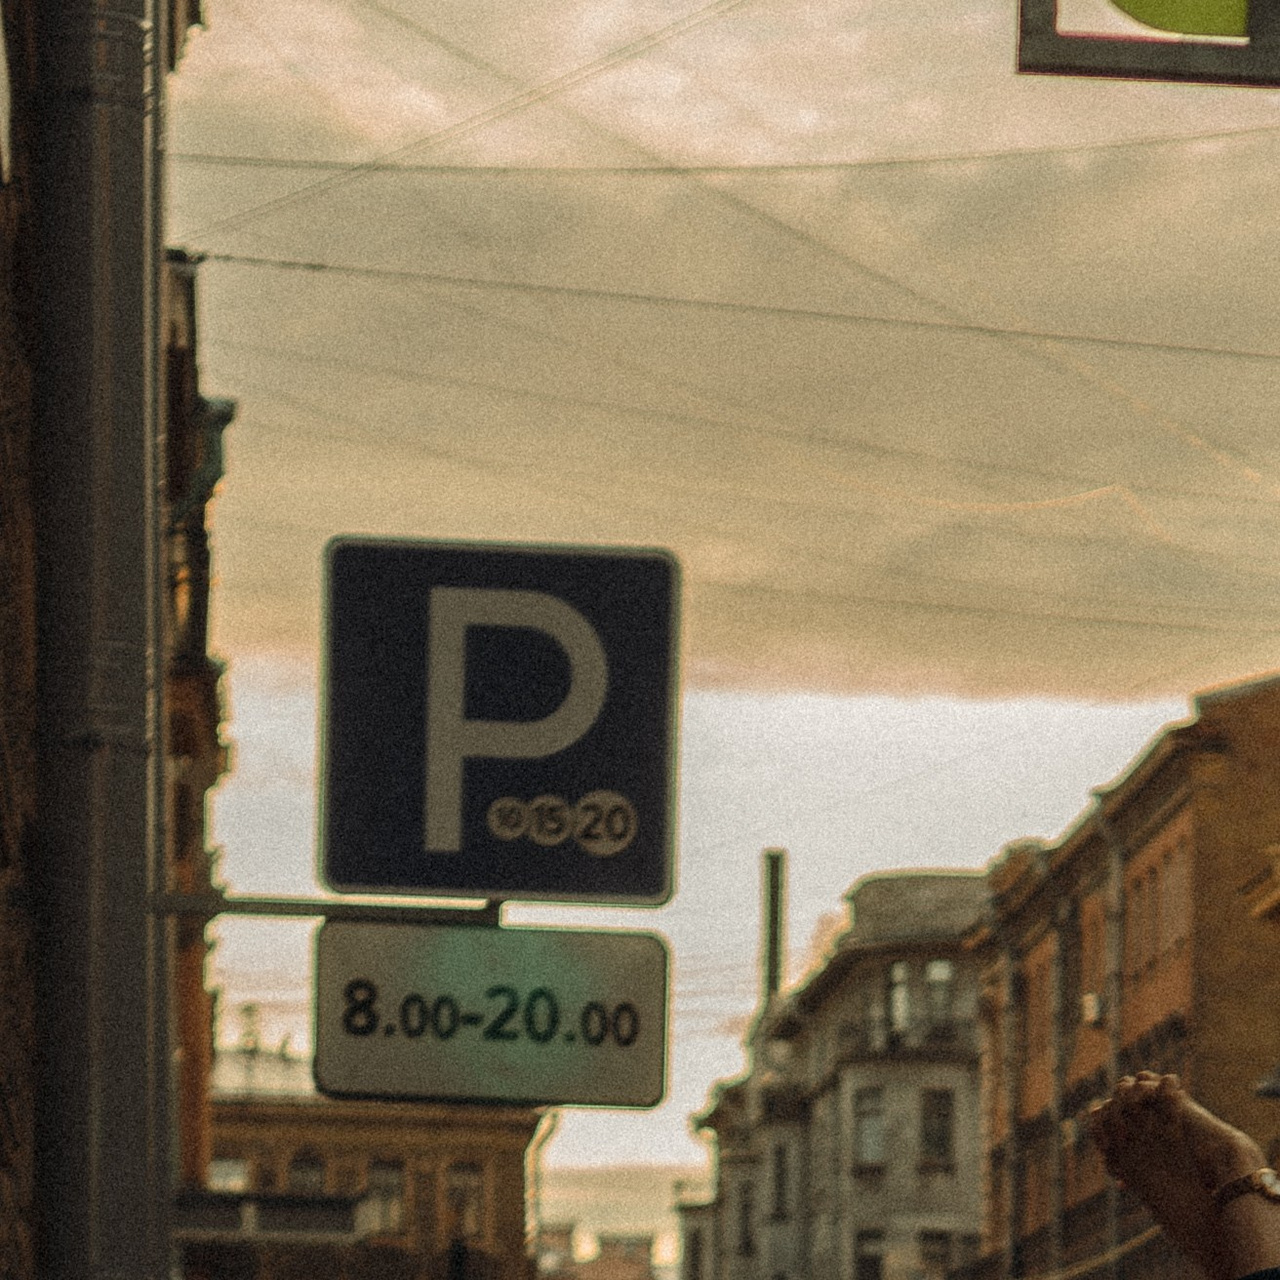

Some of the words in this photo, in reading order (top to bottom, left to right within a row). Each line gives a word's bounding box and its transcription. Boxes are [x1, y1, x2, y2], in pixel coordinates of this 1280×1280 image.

[424, 585, 609, 853] P
[535, 803, 567, 836] 15
[581, 802, 632, 842] 20
[342, 978, 641, 1047] 8.00-20.00
